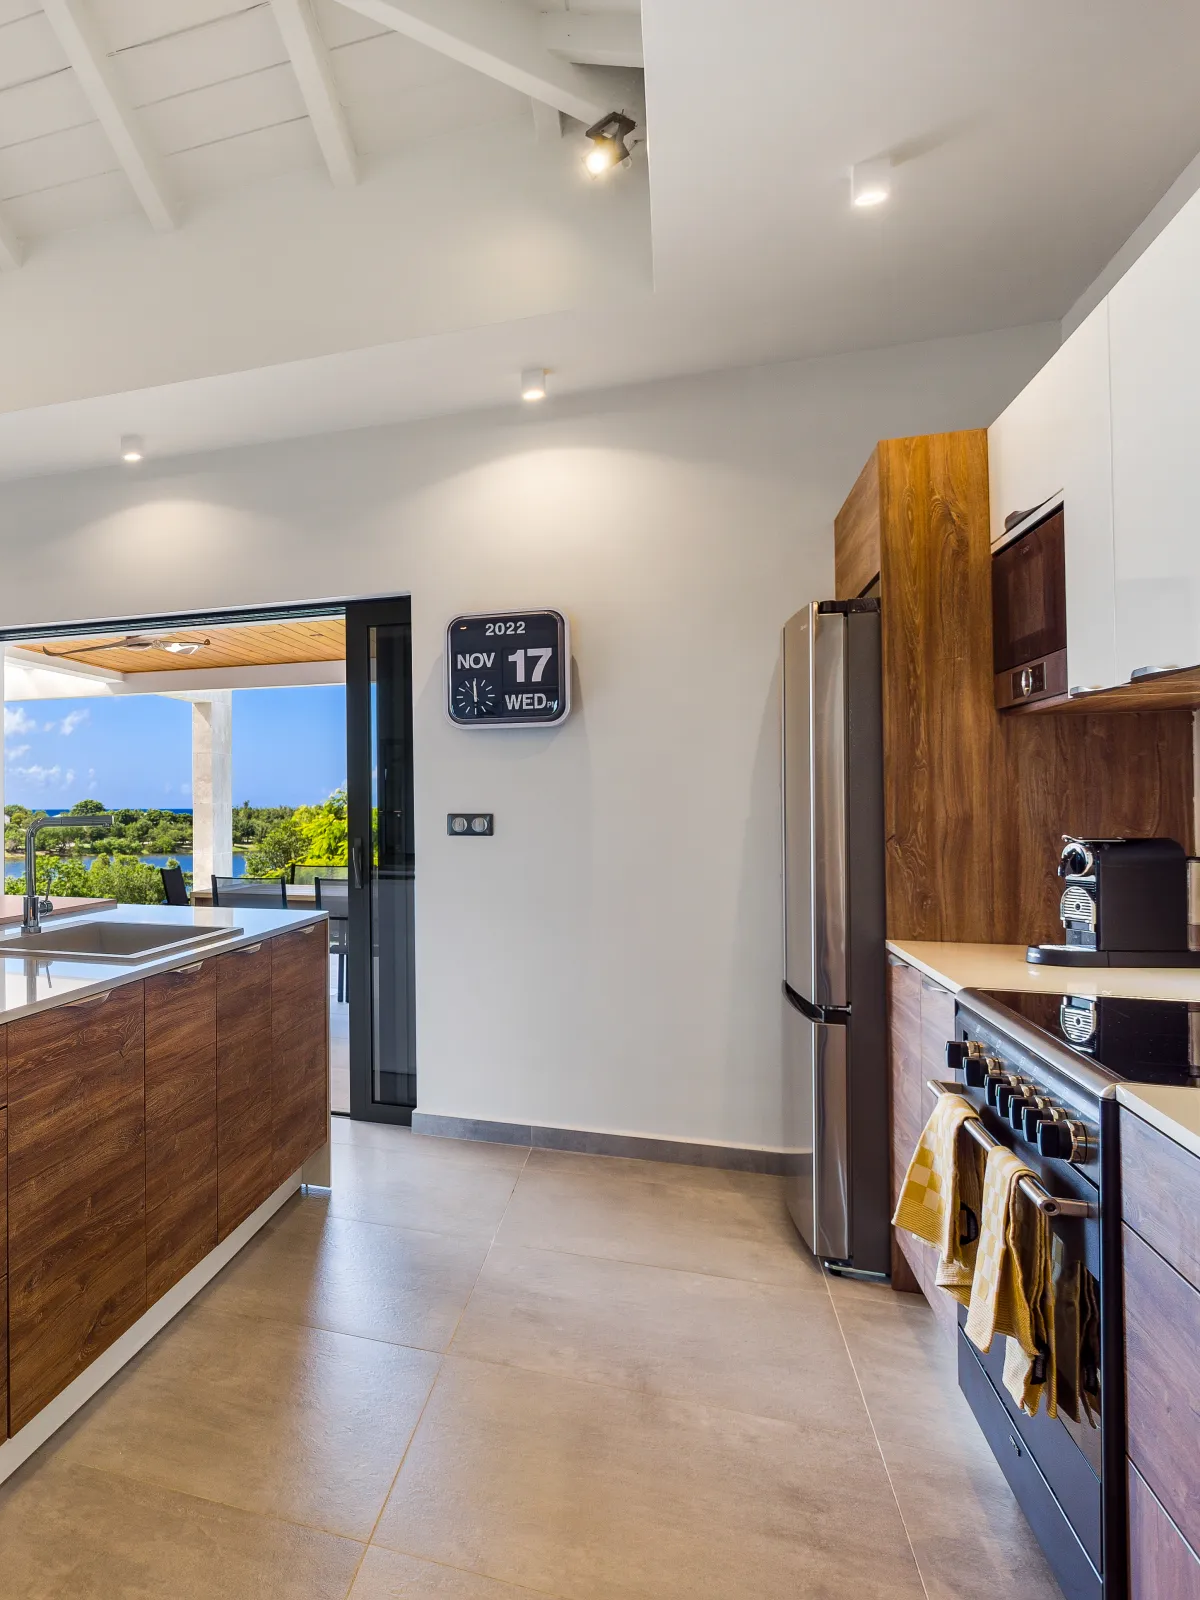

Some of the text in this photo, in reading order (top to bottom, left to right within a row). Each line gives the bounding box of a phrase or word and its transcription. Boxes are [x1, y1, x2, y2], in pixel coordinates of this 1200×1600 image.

[485, 621, 526, 636] 2022
[457, 652, 496, 669] NOV
[508, 647, 552, 683] 17
[504, 693, 547, 710] WED
